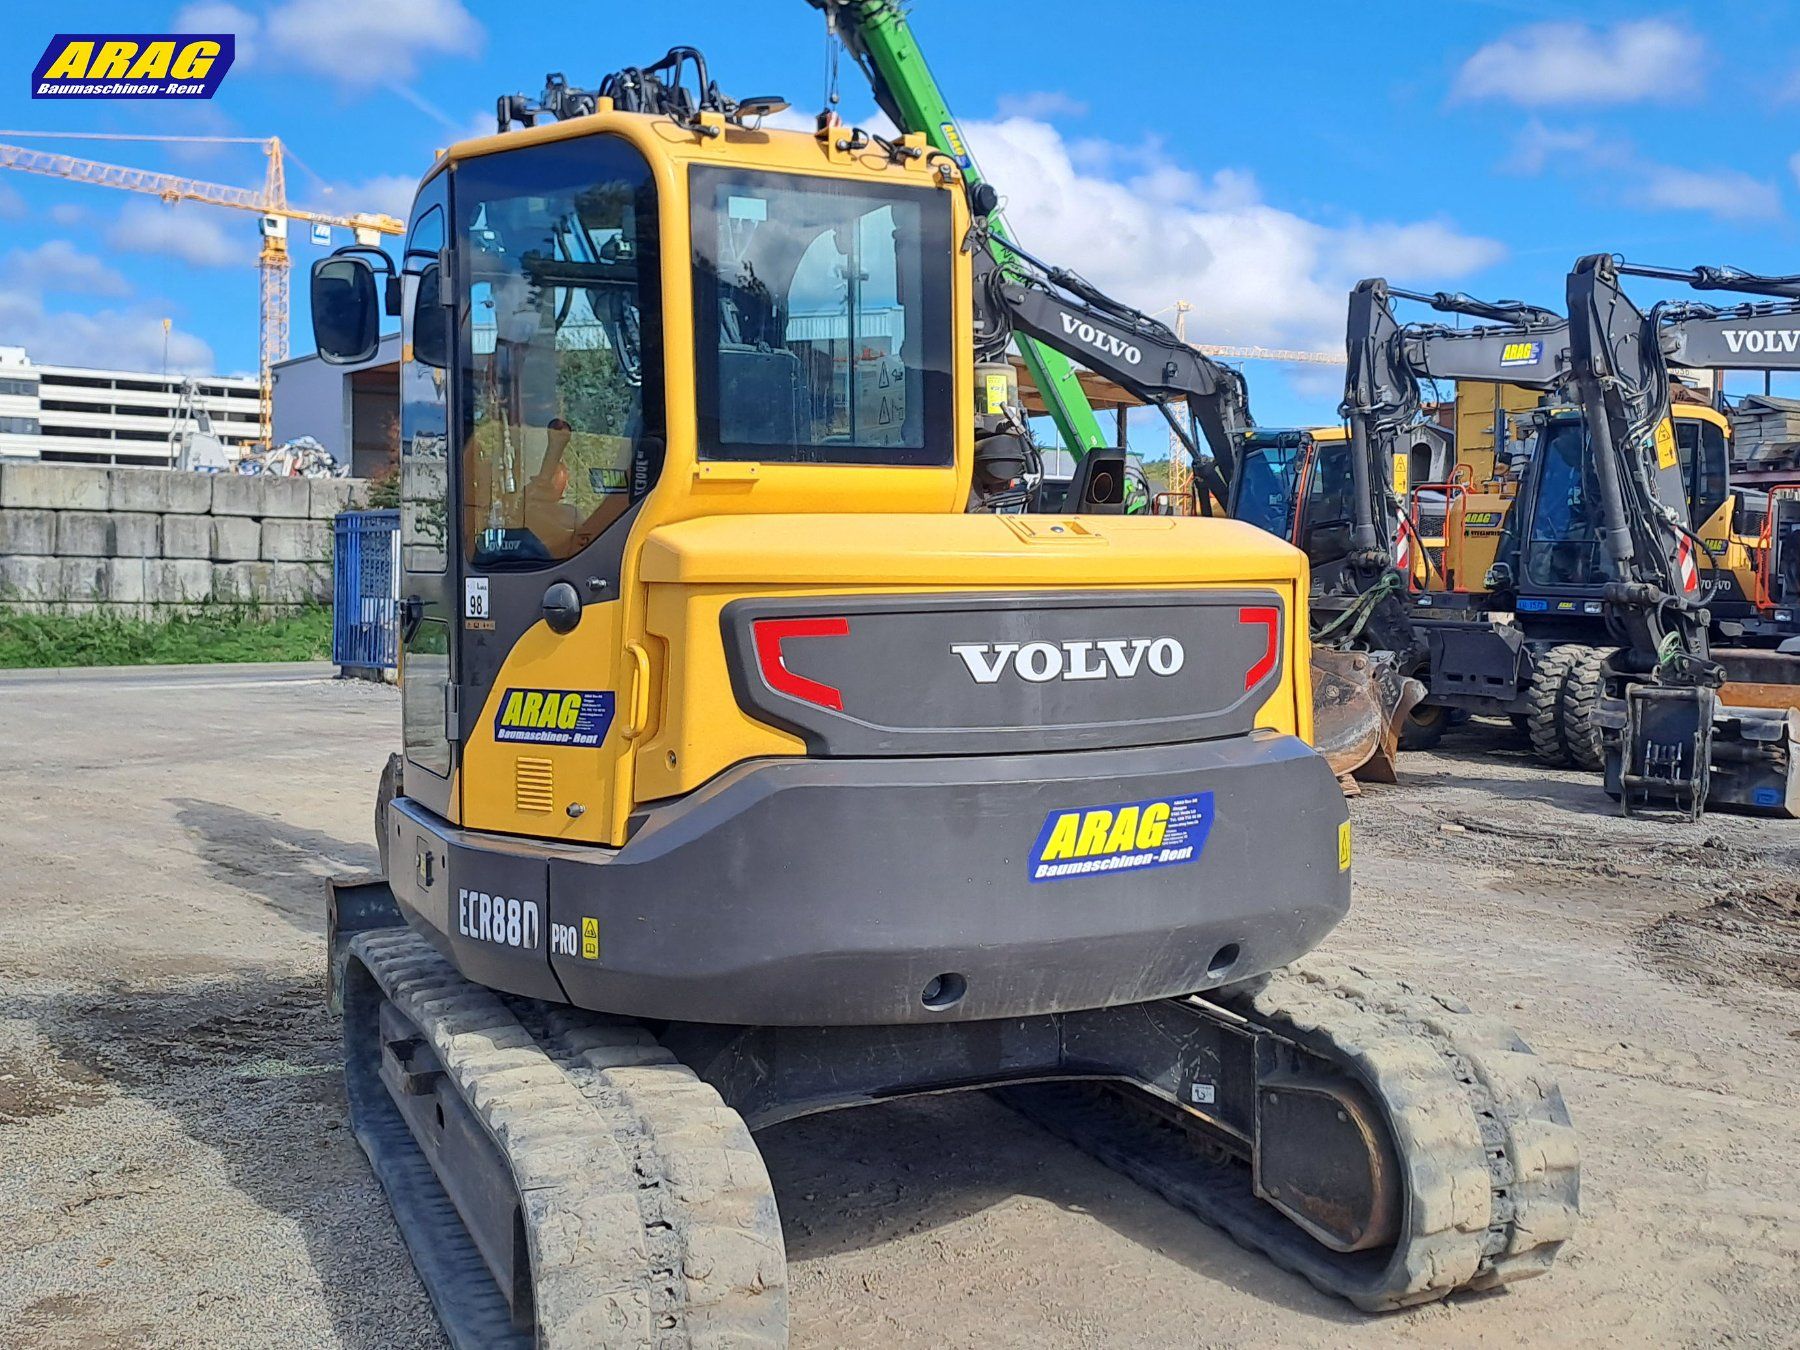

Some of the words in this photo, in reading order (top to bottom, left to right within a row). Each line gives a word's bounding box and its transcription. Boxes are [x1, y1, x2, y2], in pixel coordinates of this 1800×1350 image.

[1060, 312, 1141, 365] VOLVO
[1502, 343, 1532, 360] ARAG
[470, 594, 483, 615] 98
[951, 637, 1185, 684] VOLVO
[501, 691, 582, 730] ARAG
[1040, 802, 1171, 861] ARAG
[459, 888, 539, 950] ECR88D
[551, 922, 578, 957] PRO
